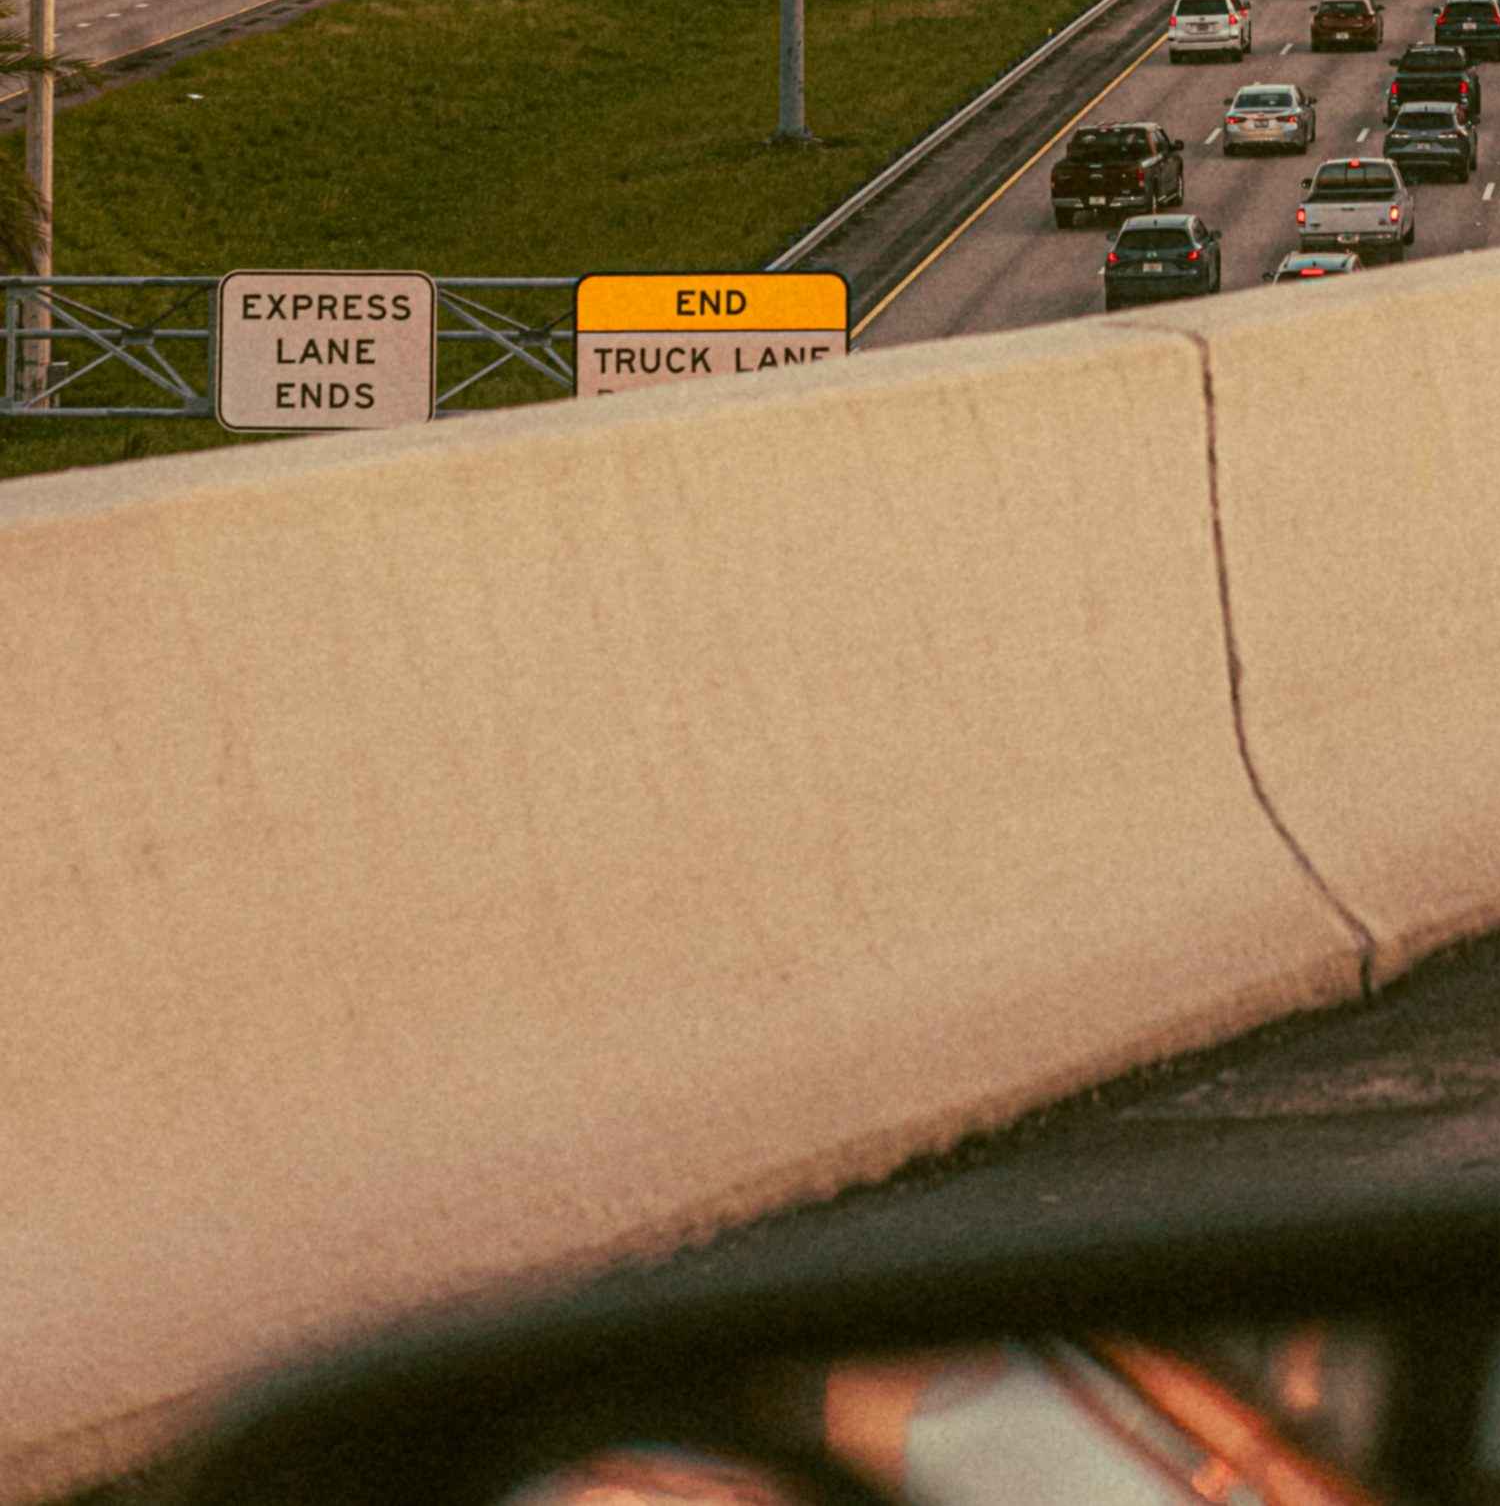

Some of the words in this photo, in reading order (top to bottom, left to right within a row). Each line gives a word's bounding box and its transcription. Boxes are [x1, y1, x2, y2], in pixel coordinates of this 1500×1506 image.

[242, 293, 412, 321] EXPRESS
[677, 289, 747, 316] END
[276, 338, 375, 365] LANE
[594, 347, 712, 374] TRUCK
[276, 382, 375, 409] ENDS
